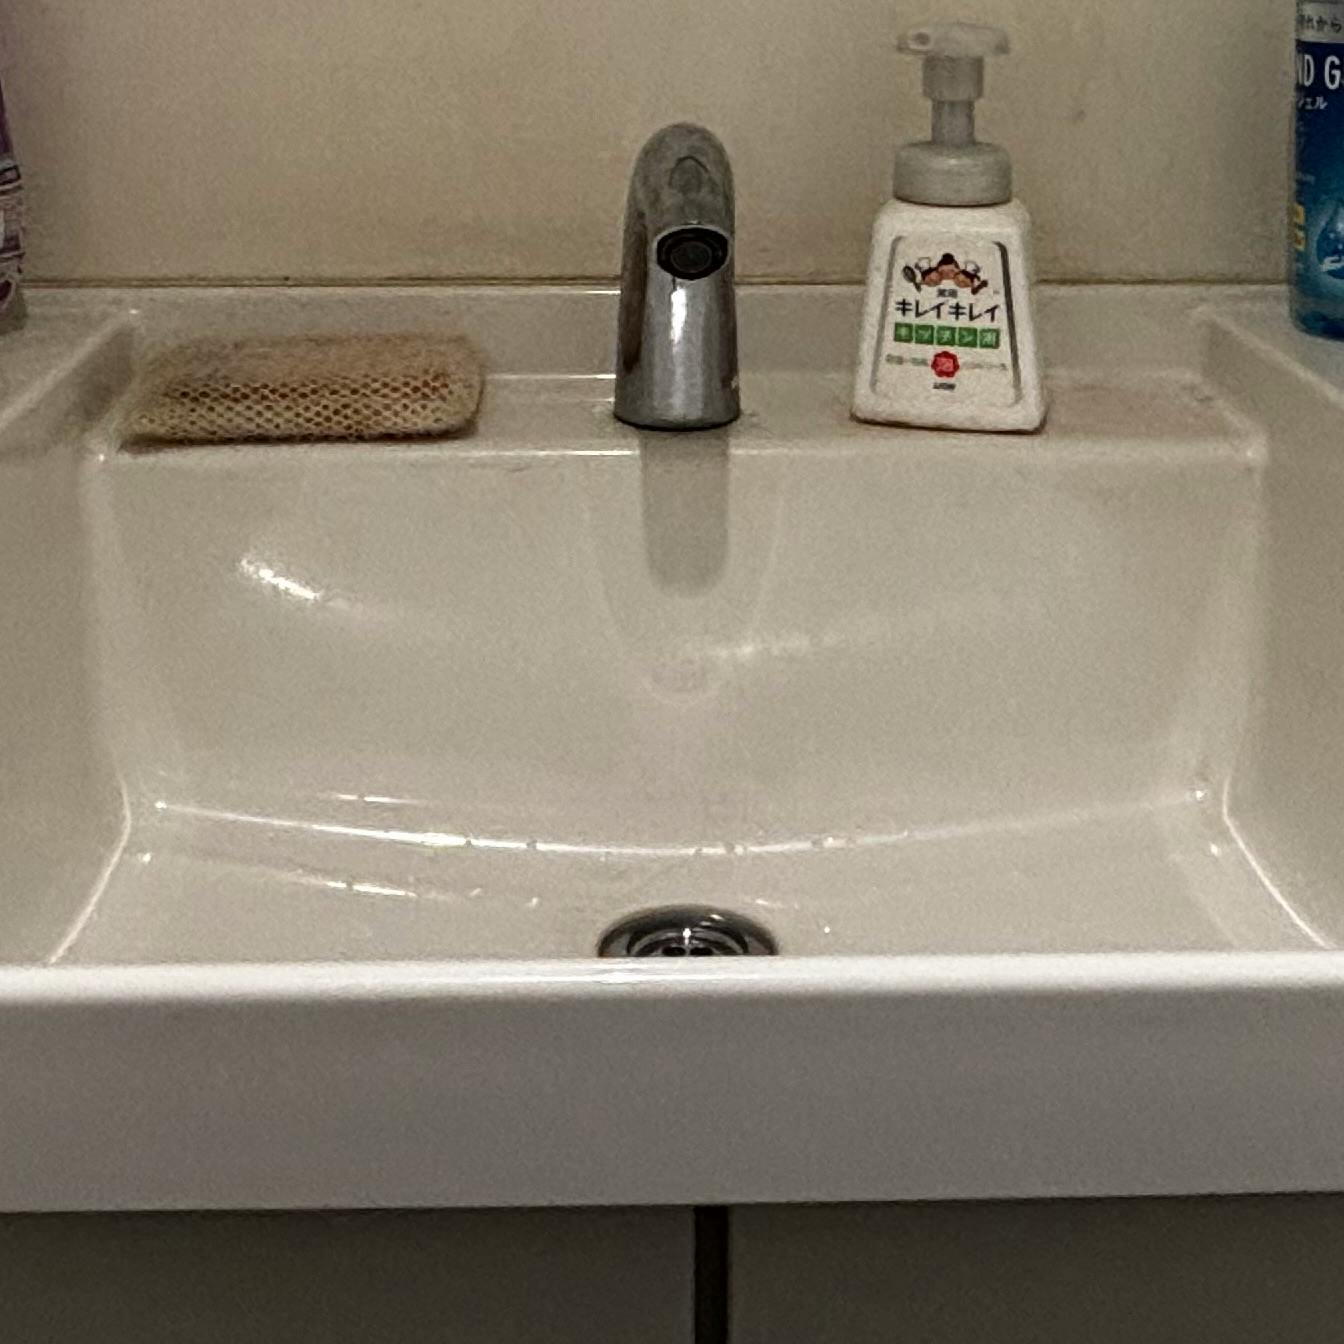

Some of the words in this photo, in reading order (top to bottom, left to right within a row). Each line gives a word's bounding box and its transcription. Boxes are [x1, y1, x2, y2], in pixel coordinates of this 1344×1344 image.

[895, 297, 999, 323] キレイキレイ
